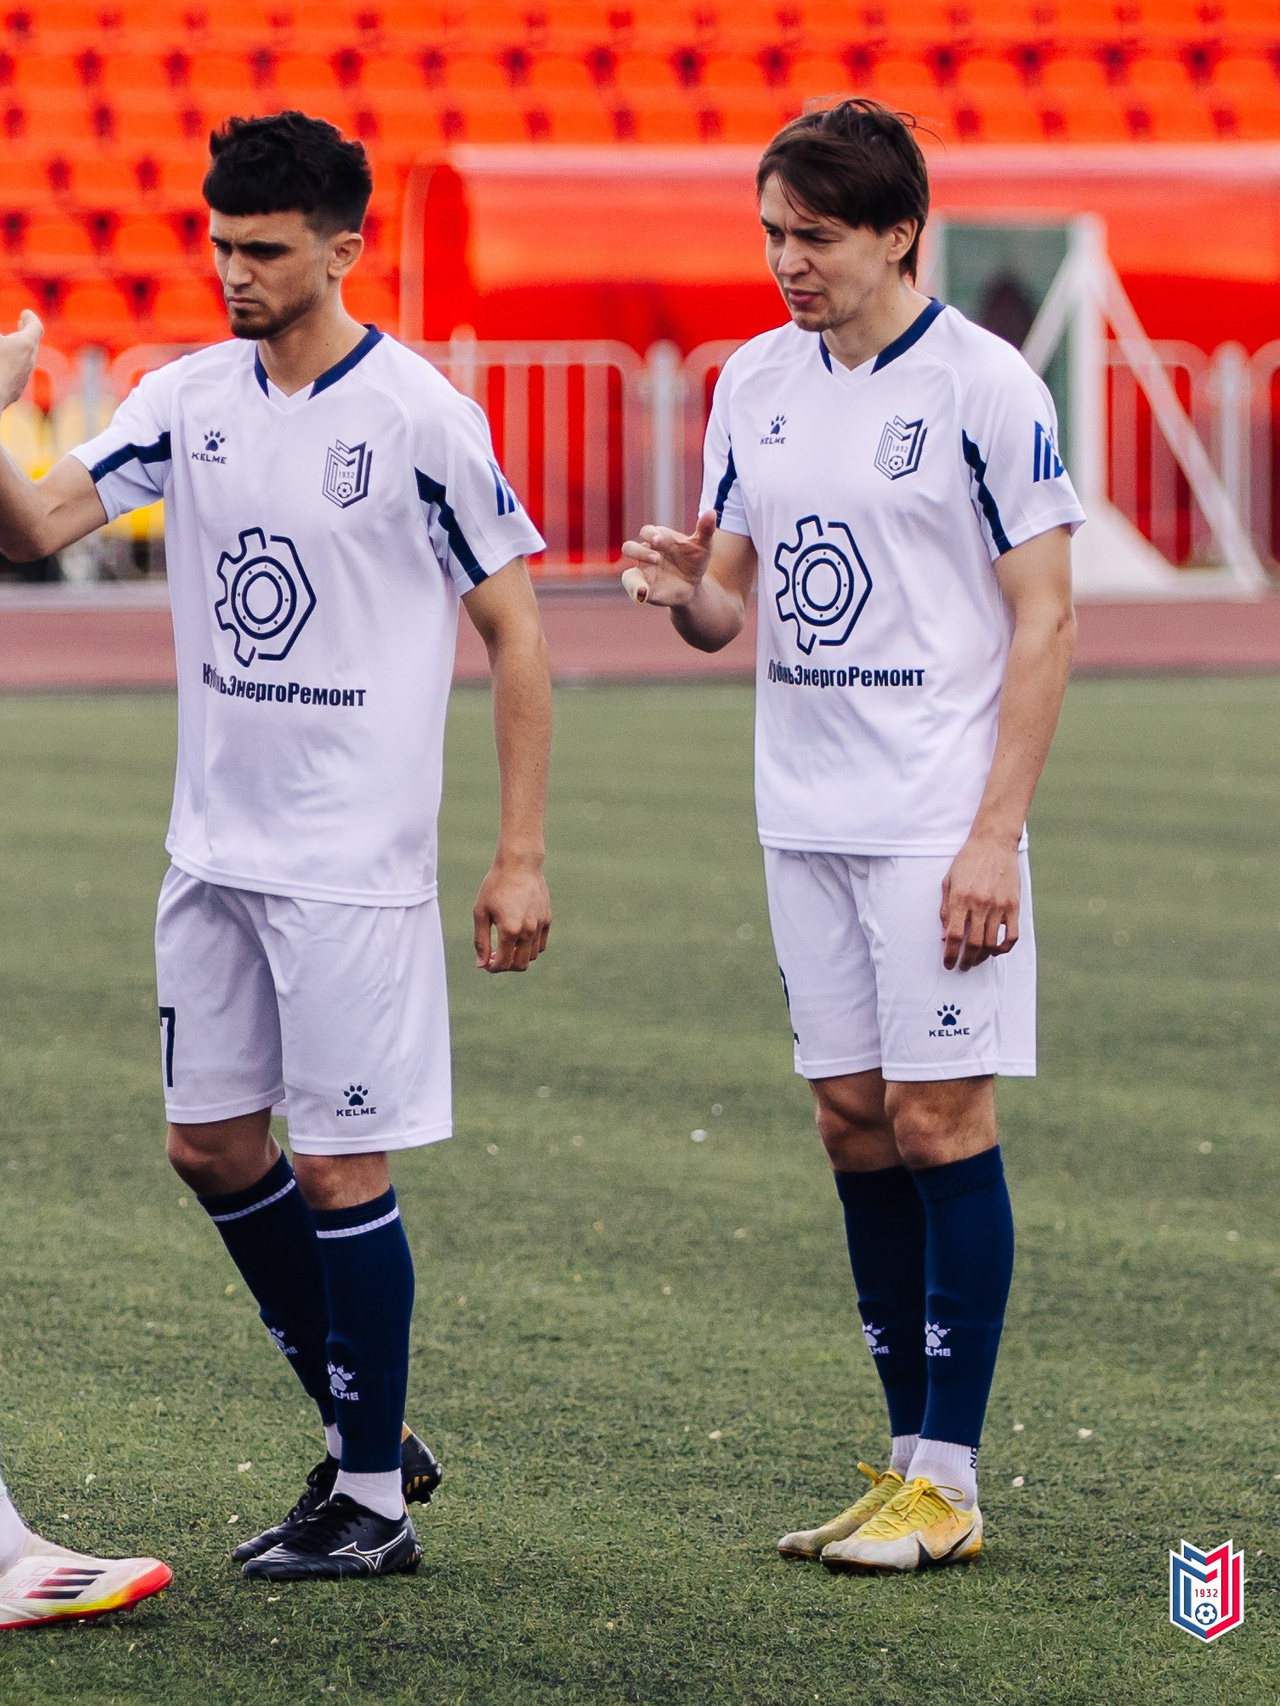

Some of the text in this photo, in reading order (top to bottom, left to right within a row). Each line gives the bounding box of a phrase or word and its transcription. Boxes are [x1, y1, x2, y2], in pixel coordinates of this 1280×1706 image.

[191, 452, 227, 464] KELME
[928, 1027, 970, 1038] KELME
[335, 1107, 377, 1117] KELME
